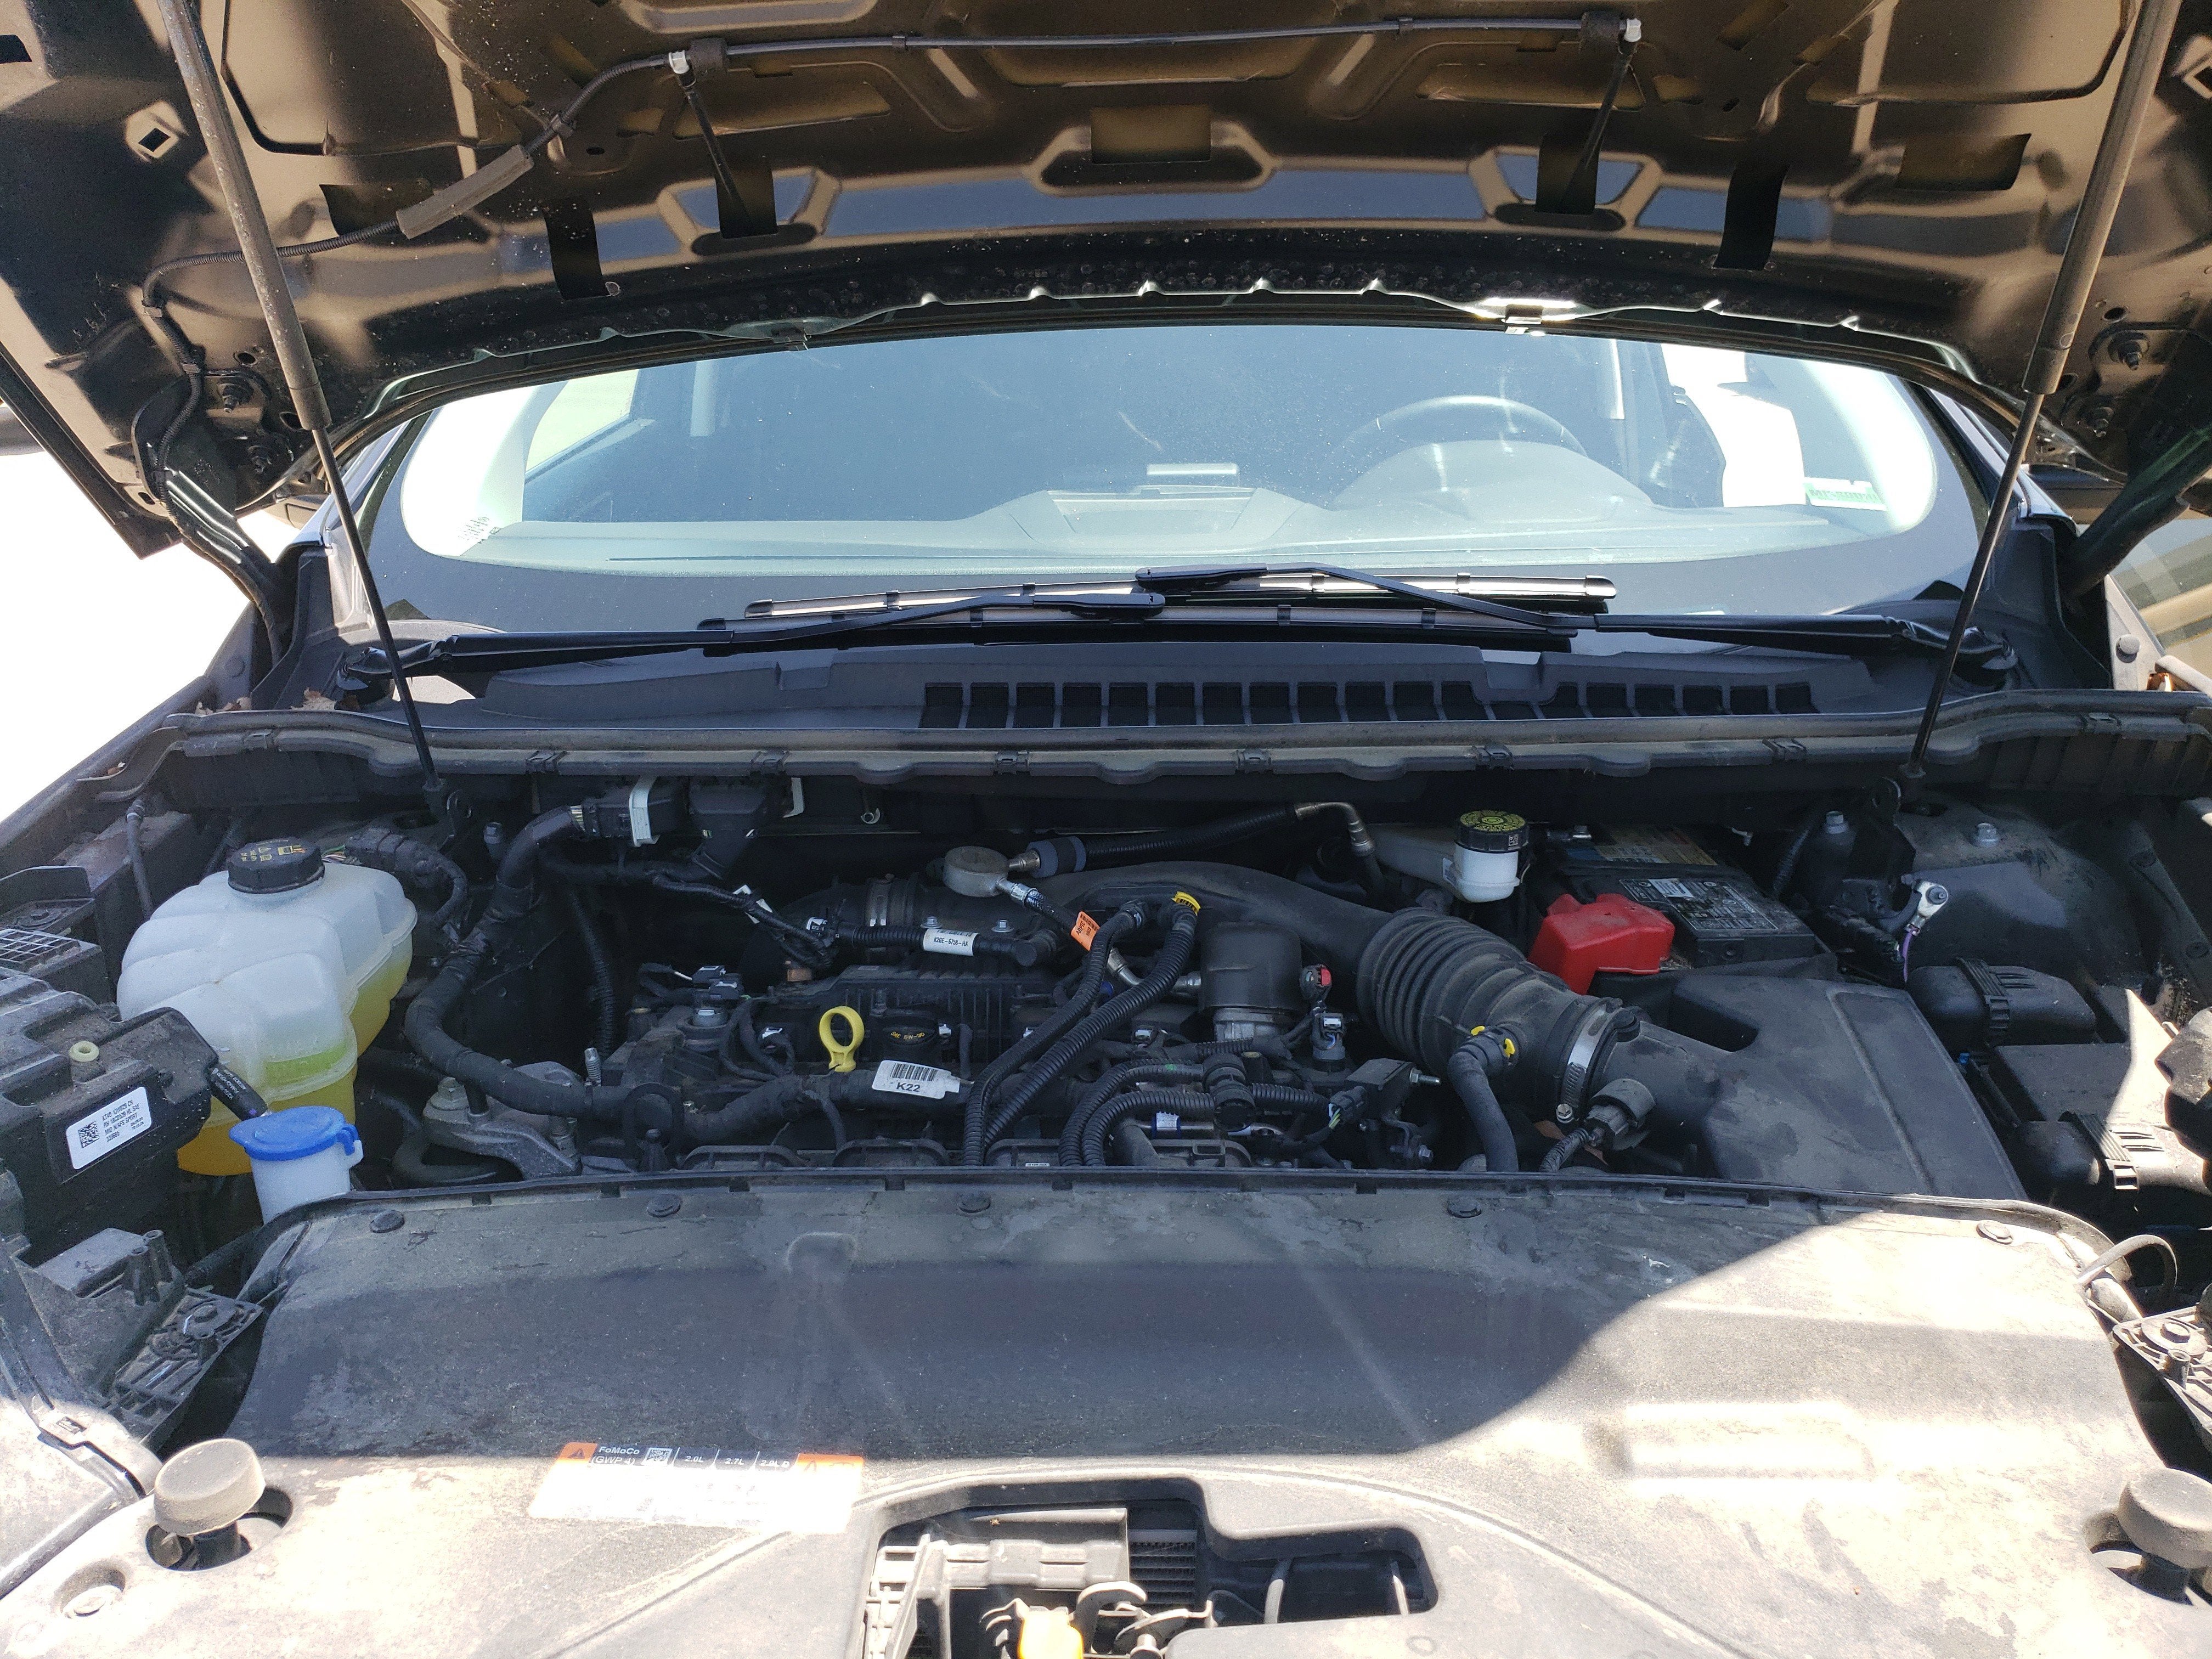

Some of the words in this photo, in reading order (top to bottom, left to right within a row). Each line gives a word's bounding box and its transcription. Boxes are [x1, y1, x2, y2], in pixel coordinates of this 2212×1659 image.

[896, 1082, 921, 1092] K22
[599, 1446, 640, 1454] FoMoCo
[591, 1455, 623, 1464] (GWP
